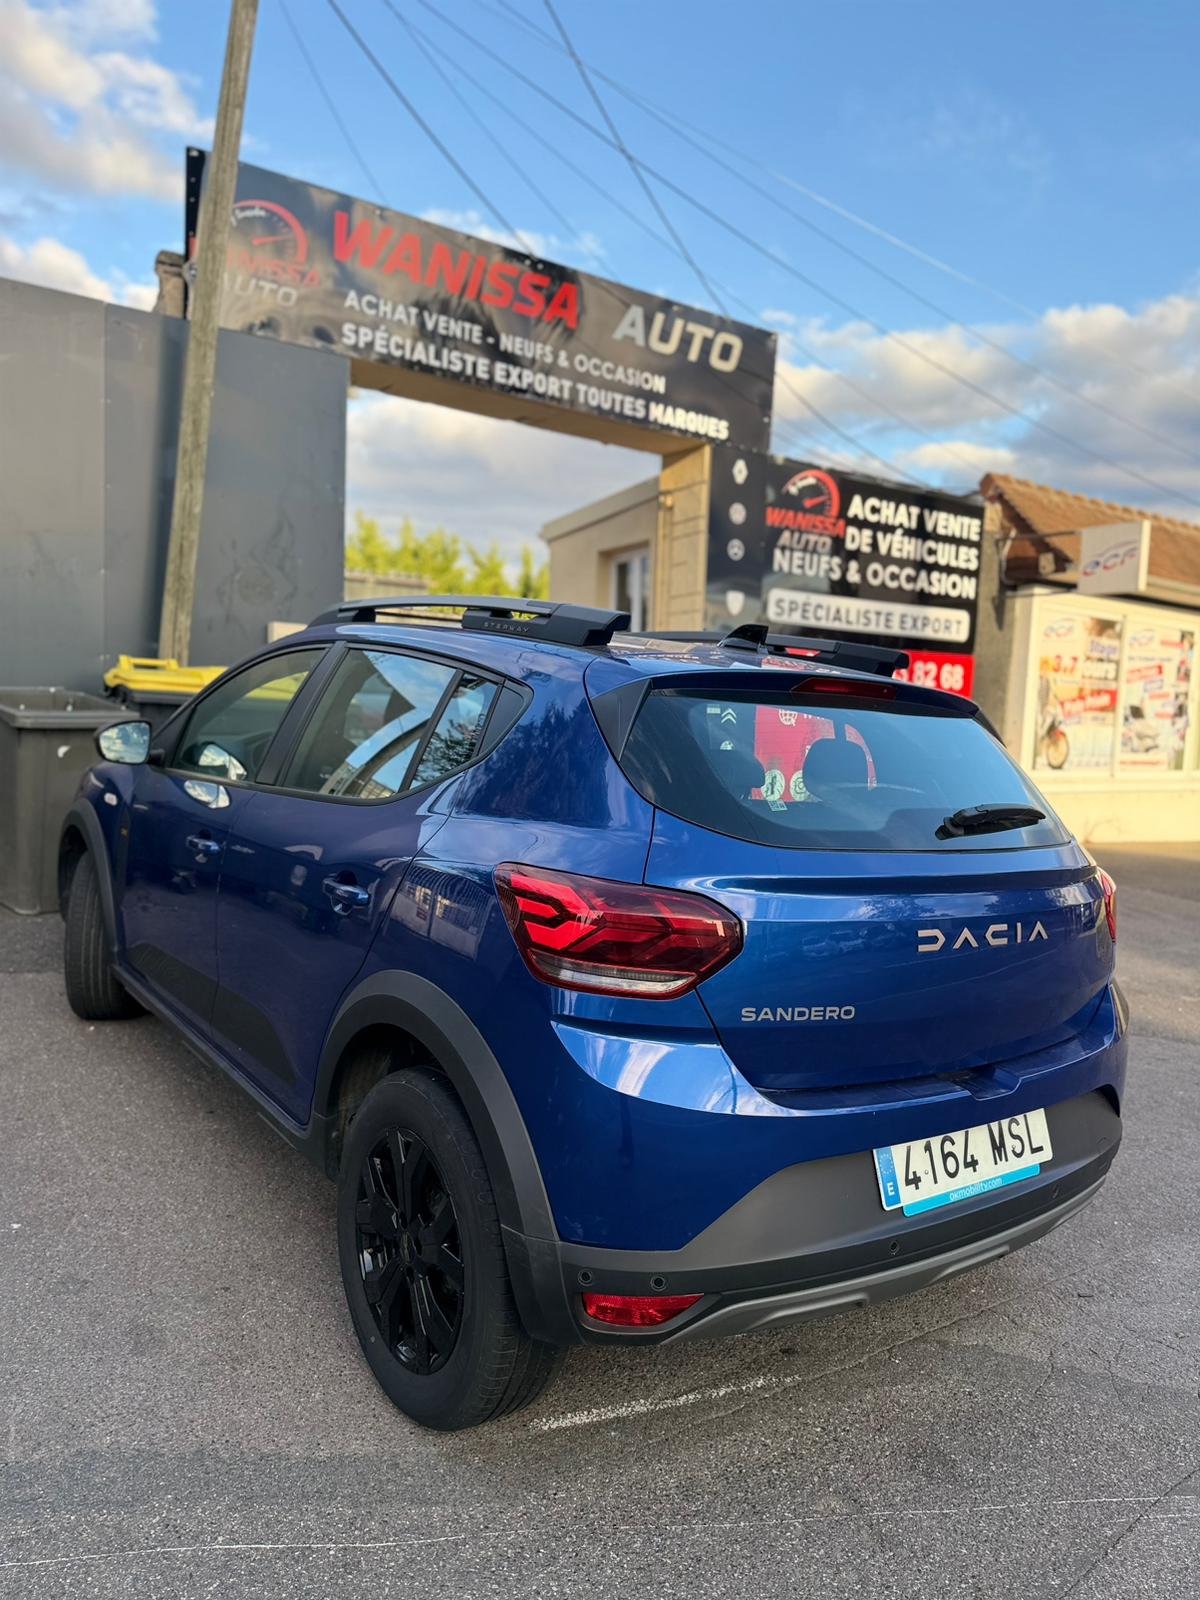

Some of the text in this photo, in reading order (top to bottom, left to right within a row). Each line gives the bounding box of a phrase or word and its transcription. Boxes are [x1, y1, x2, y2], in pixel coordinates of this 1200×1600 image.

[333, 212, 579, 329] WANISSA
[343, 289, 420, 326] ACHAT
[423, 311, 483, 344] VENTE
[501, 333, 555, 365] NEUFS
[557, 349, 569, 368] &
[574, 355, 666, 394] OCCASION
[612, 304, 743, 373] AUTO
[342, 323, 729, 441] SPÉCIALISTE EXPORT TOUTES MARQUES
[765, 507, 847, 538] WANISSA
[848, 494, 982, 542] ACHAT VENTE
[777, 530, 832, 554] AUTO
[845, 525, 979, 571] DE VÉHICULES
[773, 548, 977, 600] NEUFS & OCCASION
[774, 593, 963, 636] SPÉCIALISTE EXPORT
[913, 660, 938, 688] 82
[941, 663, 964, 691] 68
[917, 920, 1049, 952] DACIA
[741, 1005, 856, 1022] SANDERO
[904, 1114, 1044, 1190] 4164 MSL
[887, 1181, 895, 1196] E
